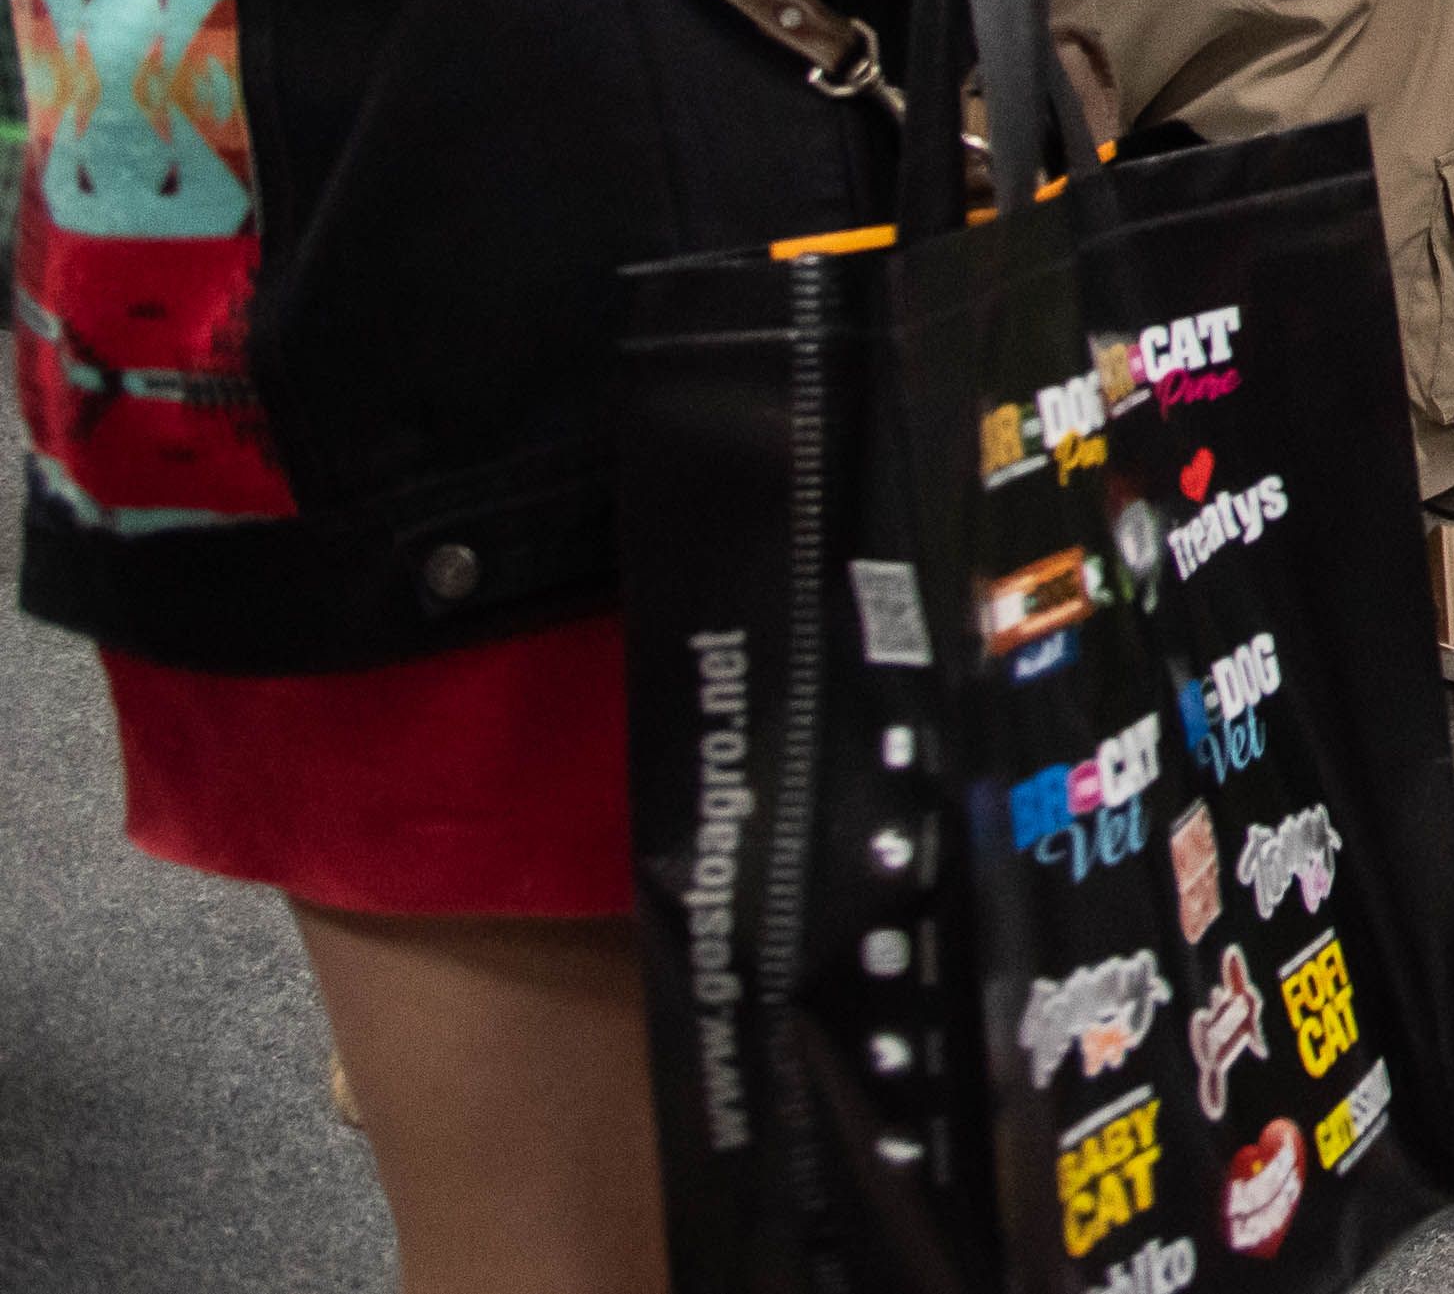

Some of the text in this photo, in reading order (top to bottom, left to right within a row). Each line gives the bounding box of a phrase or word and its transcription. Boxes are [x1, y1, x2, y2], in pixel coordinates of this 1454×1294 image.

[1139, 305, 1241, 383] CAT
[1211, 632, 1282, 721] DOG
[1299, 986, 1359, 1079] CAT
[1062, 1144, 1161, 1258] CAT
